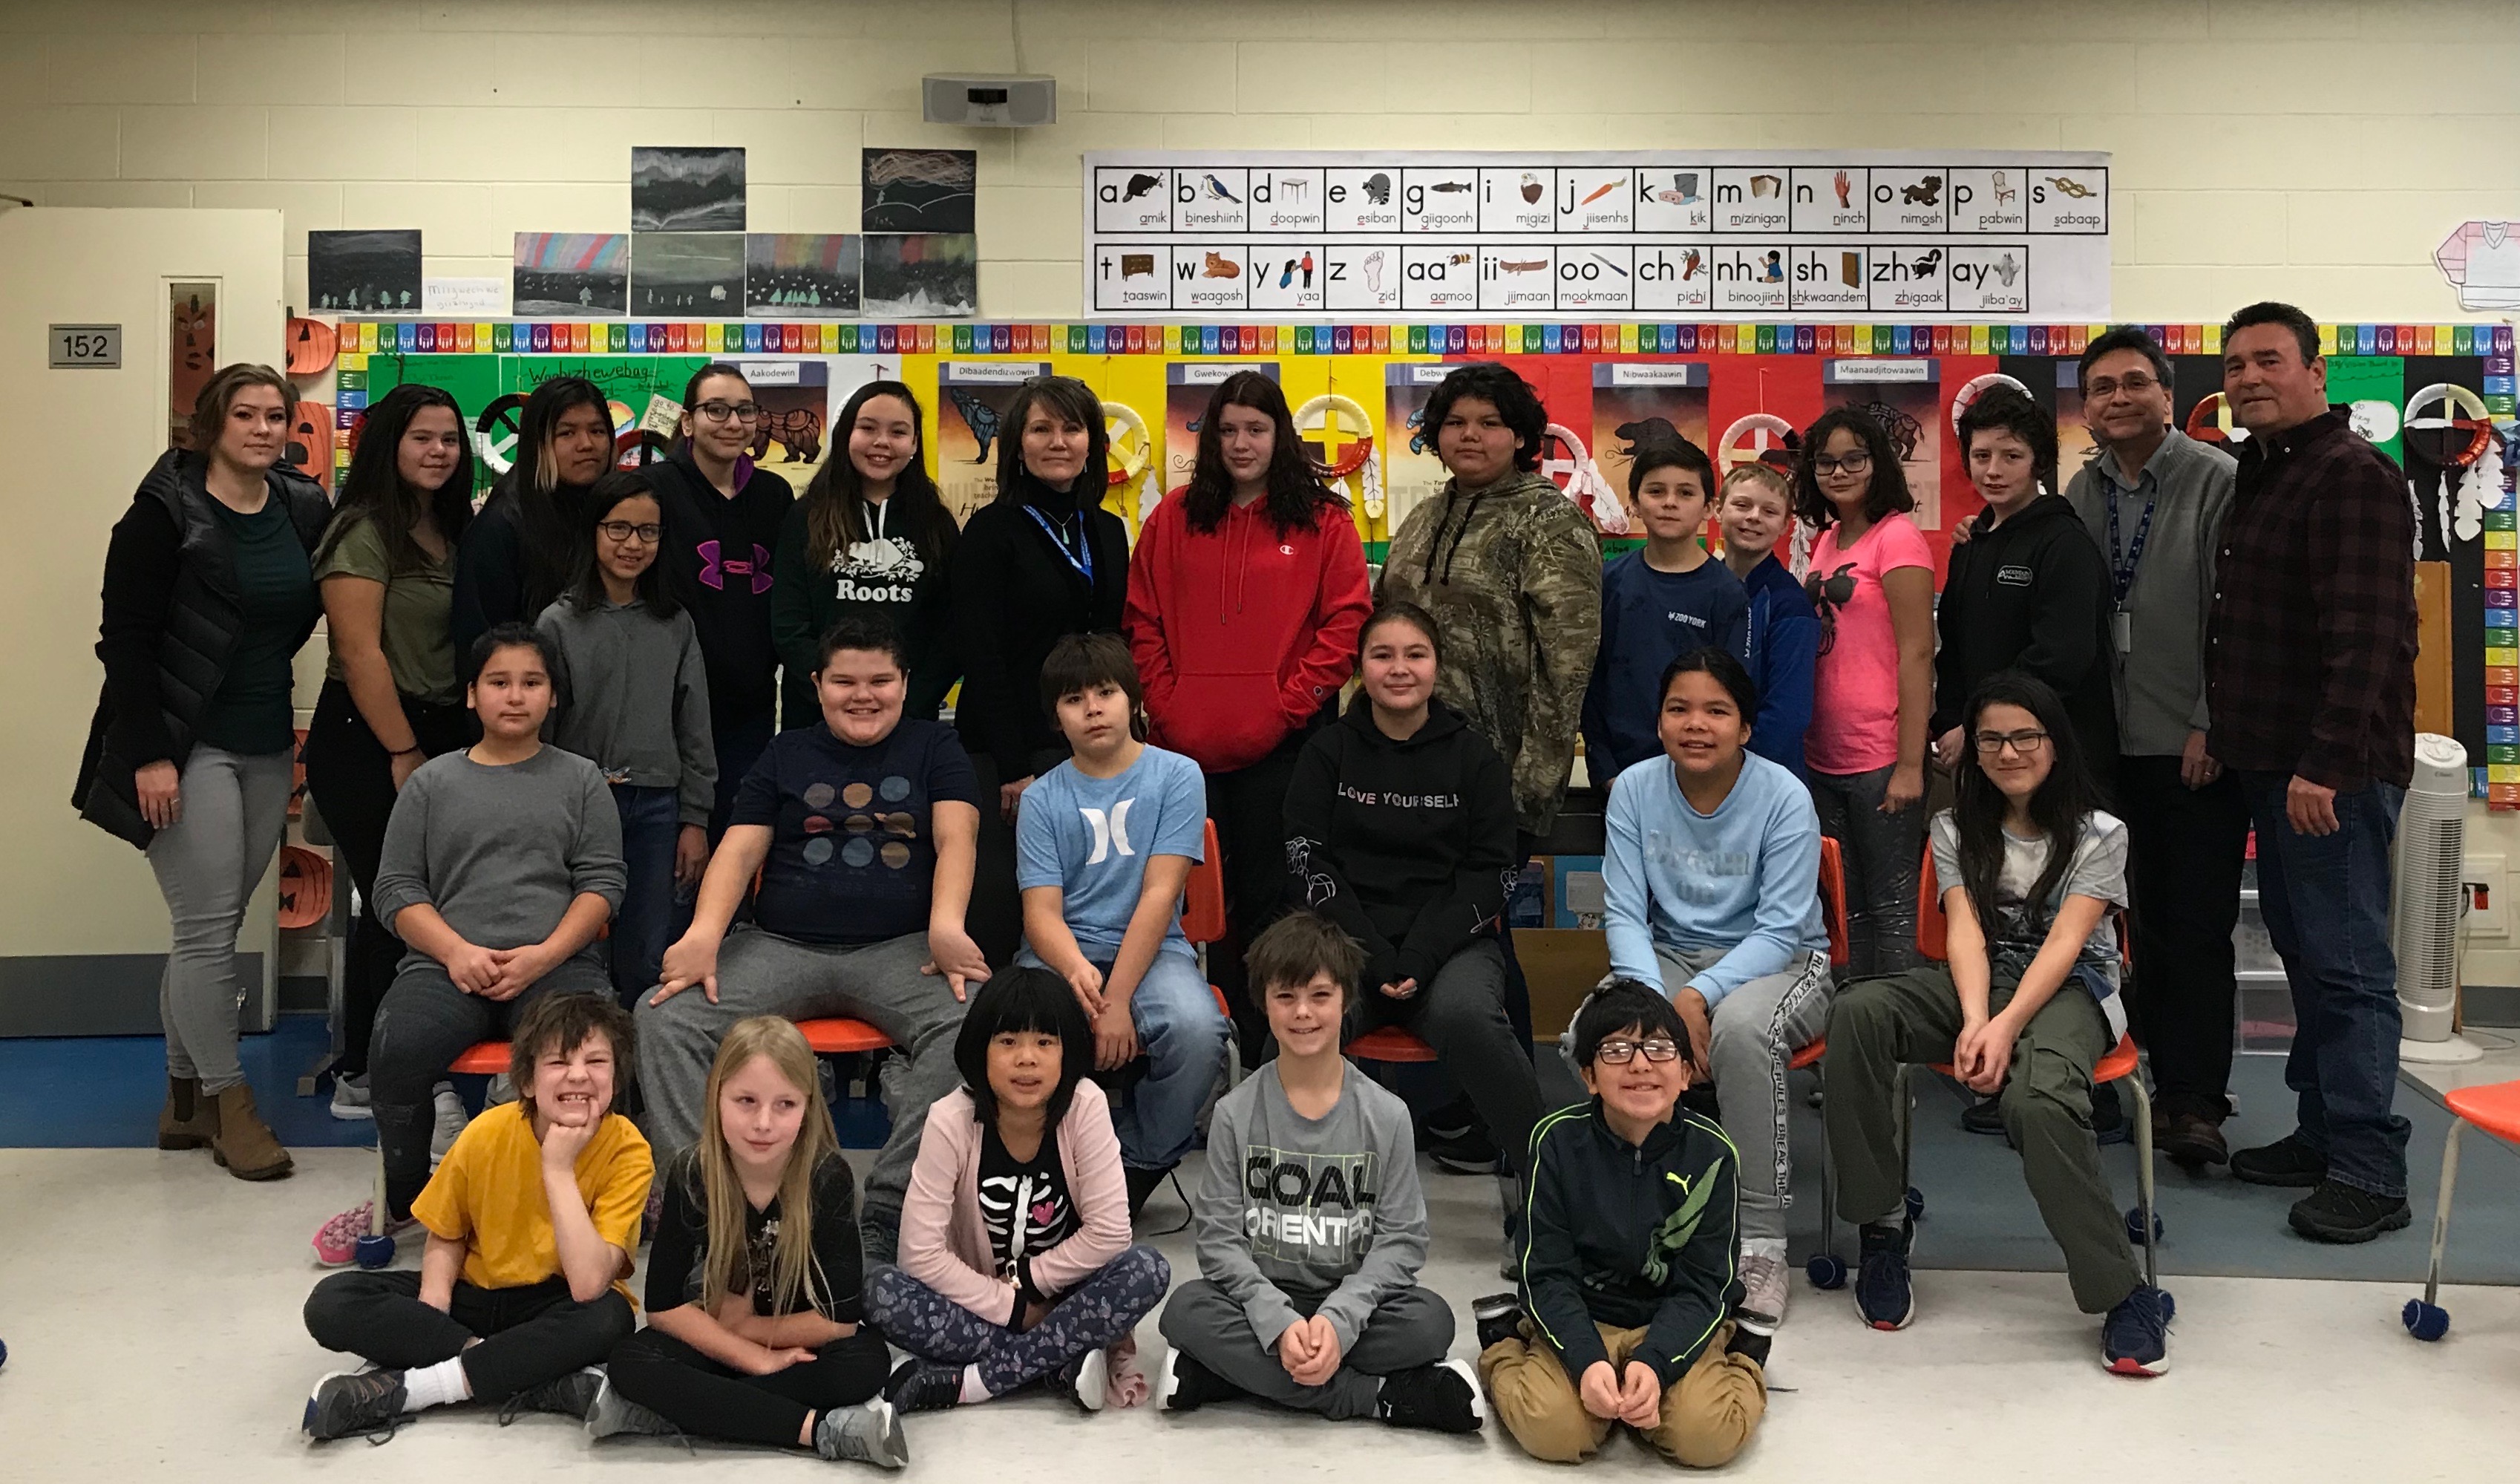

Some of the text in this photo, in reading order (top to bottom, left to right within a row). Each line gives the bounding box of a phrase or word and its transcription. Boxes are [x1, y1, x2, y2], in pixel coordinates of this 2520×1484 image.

[1100, 185, 1117, 203] a
[1179, 173, 1195, 203] b
[1254, 173, 1271, 203] d
[1329, 186, 1346, 203] e
[1487, 180, 1490, 203] i
[1640, 173, 1655, 203] k
[1718, 185, 1741, 203] m
[1797, 186, 1813, 203] n
[1875, 185, 1893, 203] o
[2033, 186, 2045, 203] s
[1407, 186, 1424, 215] g
[1561, 180, 1574, 214] j
[1955, 186, 1972, 215] p
[1140, 211, 1166, 225] amik
[1185, 210, 1243, 226] bineshiinh
[1271, 211, 1319, 226] doopwin
[1358, 211, 1395, 225] esiban
[1421, 210, 1473, 229] giigoonh
[1516, 214, 1550, 228] migizi
[1583, 210, 1629, 229] jiisenhs
[1690, 211, 1706, 225] kik
[1731, 213, 1785, 228] mizinigan
[1833, 211, 1865, 226] ninch
[1902, 211, 1942, 226] nimosh
[1979, 211, 2022, 230] pabwin
[2054, 212, 2100, 229] sabaap
[1101, 257, 1112, 280] t
[1176, 263, 1196, 280] w
[1330, 263, 1346, 280] z
[1407, 263, 1445, 280] aa
[1485, 258, 1497, 280] ii
[1560, 263, 1600, 280] oo
[1640, 251, 1674, 281] ch
[1718, 251, 1752, 281] nh
[1797, 251, 1827, 281] sh
[1873, 251, 1908, 281] zh
[1254, 263, 1269, 288] y
[1953, 264, 1989, 290] ay
[1123, 291, 1166, 303] taaswin
[1191, 289, 1243, 305] waagosh
[1297, 293, 1319, 306] yaa
[1378, 290, 1395, 303] zid
[1430, 293, 1472, 304] aamoo
[1505, 291, 1550, 305] jiimaan
[1561, 290, 1627, 304] mookmaan
[1678, 289, 1706, 306] pichi
[1729, 290, 1784, 306] binoojiinh
[1791, 290, 1866, 304] shkwaandem
[1895, 290, 1943, 307] zhigaak
[63, 336, 108, 358] 152
[750, 368, 795, 377] Aakodewin
[1420, 369, 1448, 377] Debwe
[1623, 370, 1682, 378] Nibwaakaawin
[836, 579, 913, 602] Roots
[1674, 612, 1707, 629] ZOO YORK
[1338, 782, 1376, 805] LOVE
[1774, 1072, 1785, 1115] RULES
[1777, 1123, 1787, 1167] BREAK
[1246, 1156, 1376, 1209] GOAL
[1777, 1169, 1787, 1194] THE
[1246, 1207, 1373, 1246] ORIENTED
